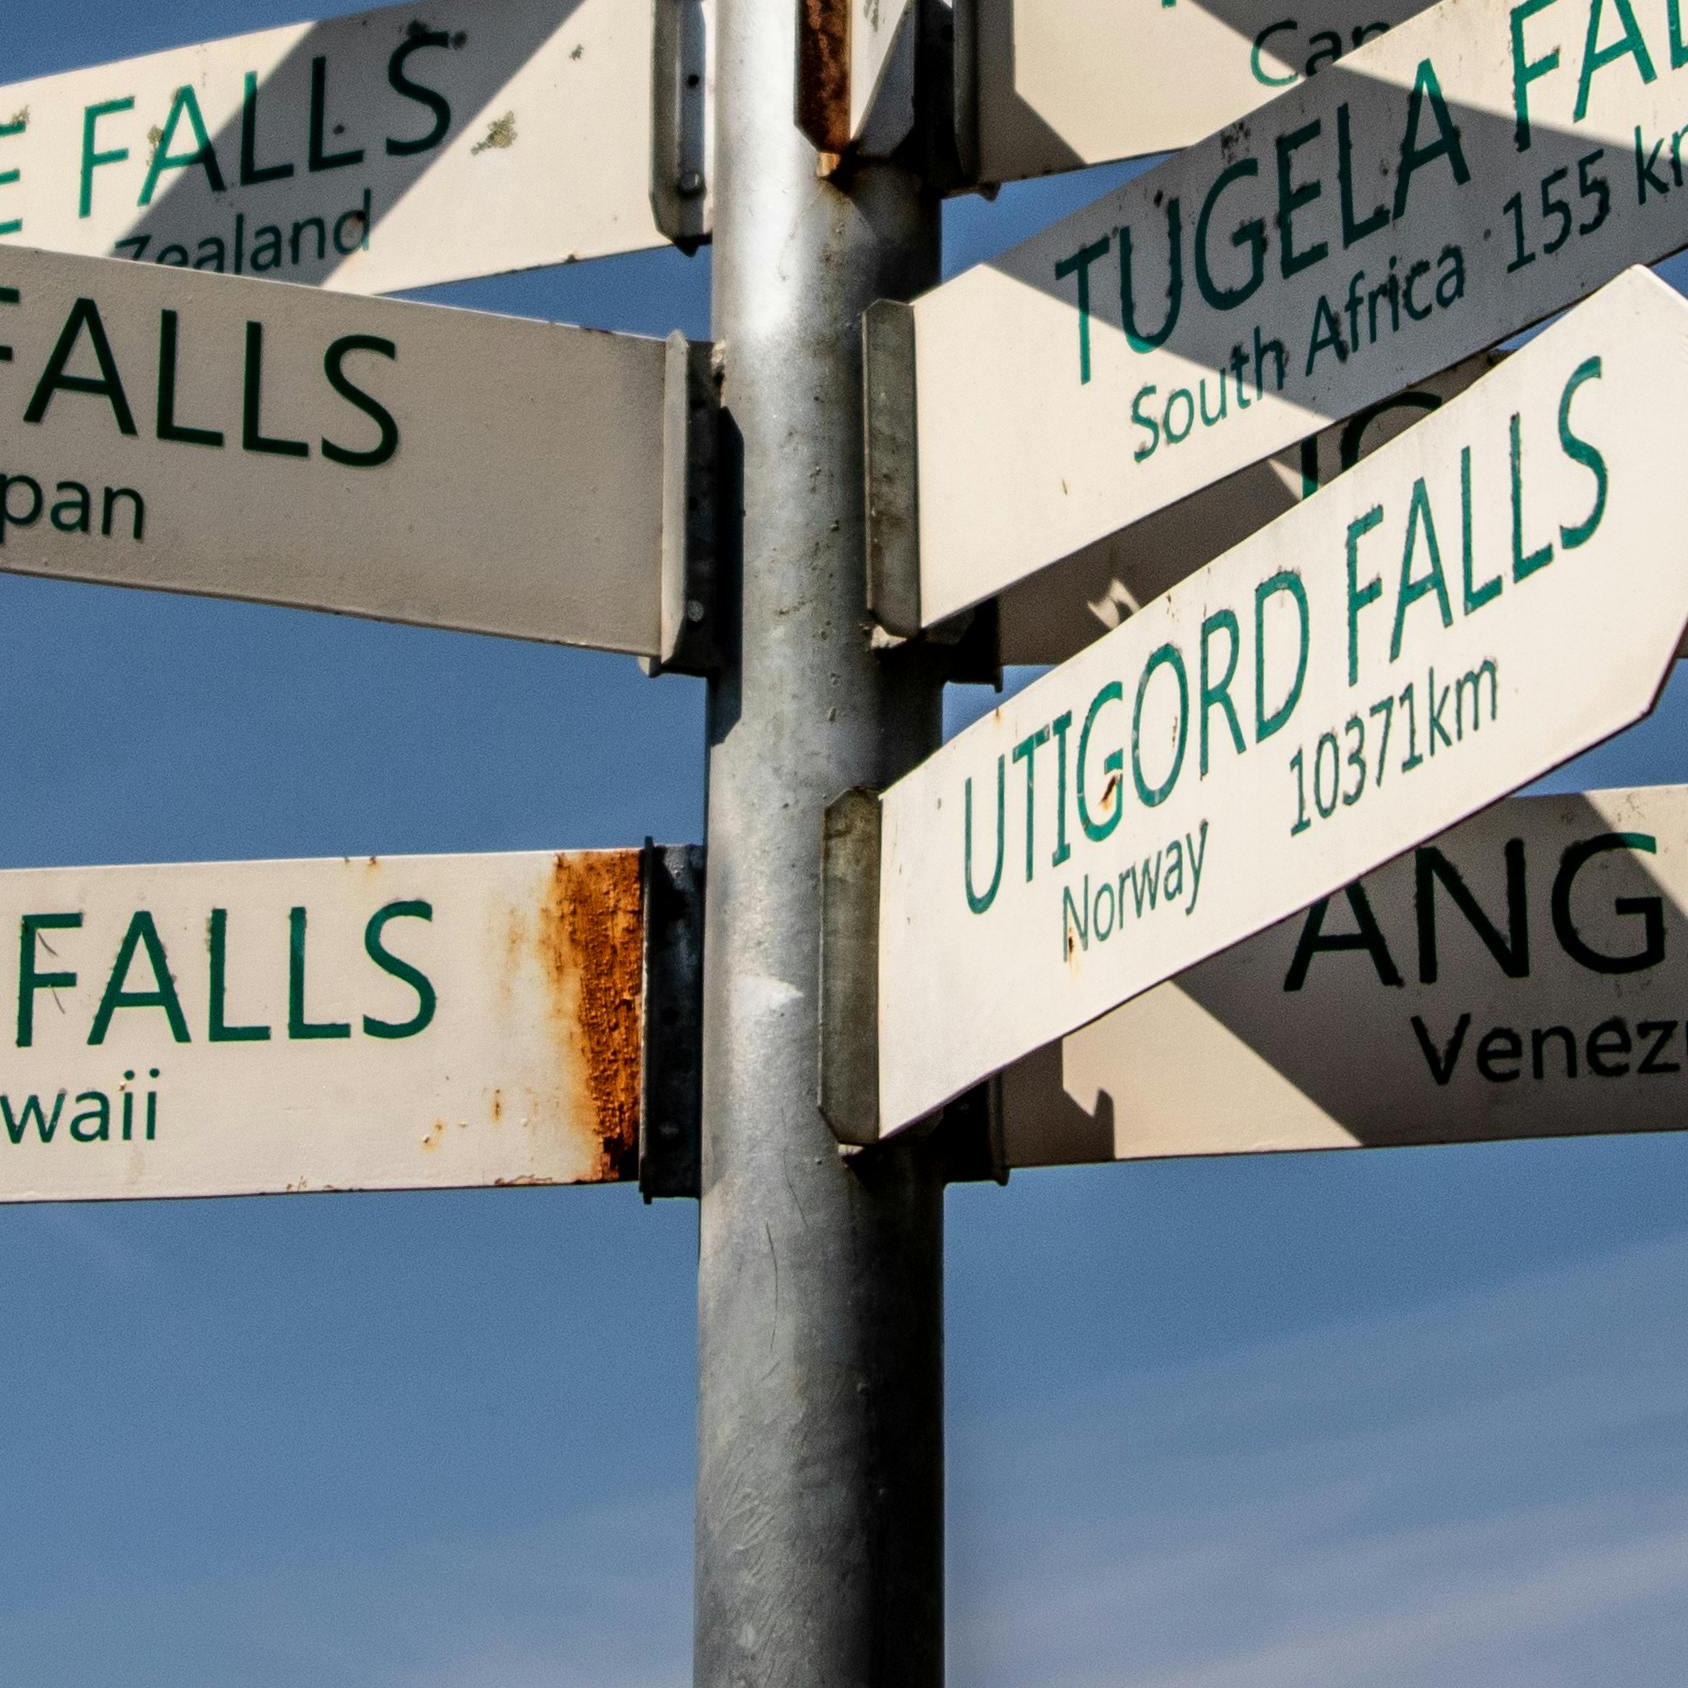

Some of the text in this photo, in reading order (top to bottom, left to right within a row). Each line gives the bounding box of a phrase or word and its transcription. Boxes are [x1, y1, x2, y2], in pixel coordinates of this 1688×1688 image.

[77, 31, 451, 220] FALLS
[1055, 57, 1473, 386] TUGELA
[1131, 324, 1287, 463] South
[1304, 243, 1466, 377] Africa
[1504, 149, 1611, 275] 155
[963, 569, 1310, 915] UTIGORD
[1346, 355, 1608, 688] FALLS
[11, 898, 437, 1049] FALLS
[1062, 819, 1209, 963] Norway
